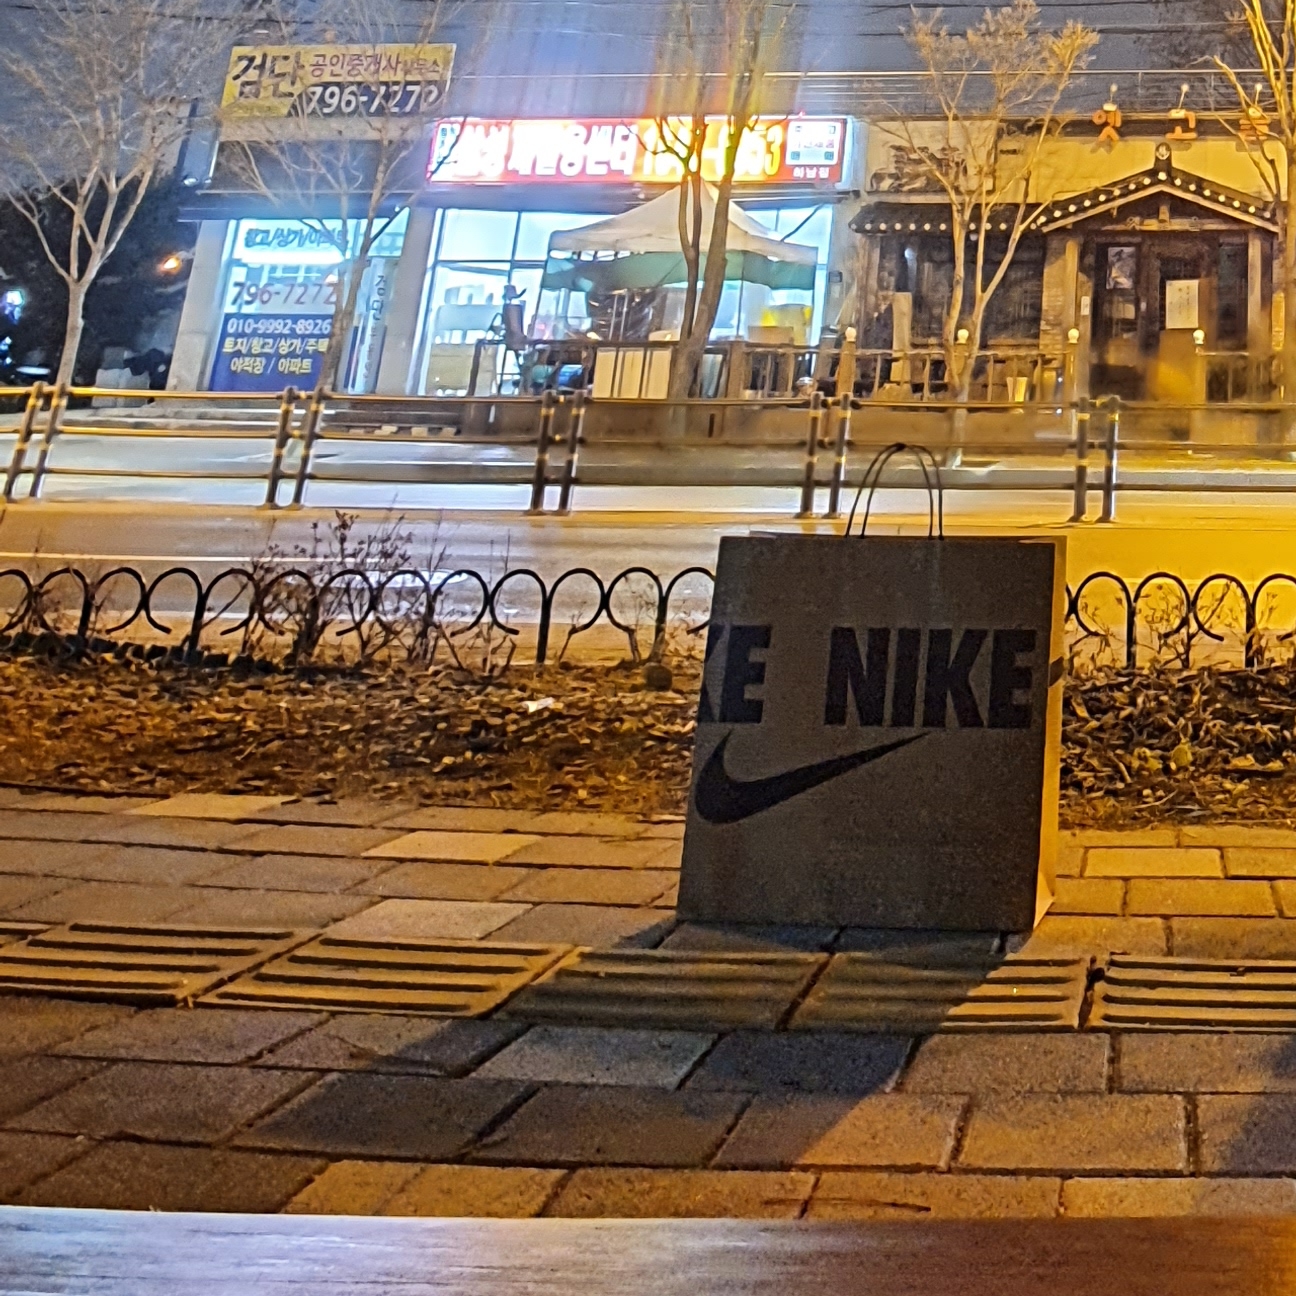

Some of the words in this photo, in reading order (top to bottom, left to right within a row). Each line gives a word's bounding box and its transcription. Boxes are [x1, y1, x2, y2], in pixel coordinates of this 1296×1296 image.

[231, 281, 339, 306] 796-7272
[227, 317, 333, 335] 010-9992-8926
[277, 357, 314, 375] 아파트
[823, 625, 1038, 730] NIKE
